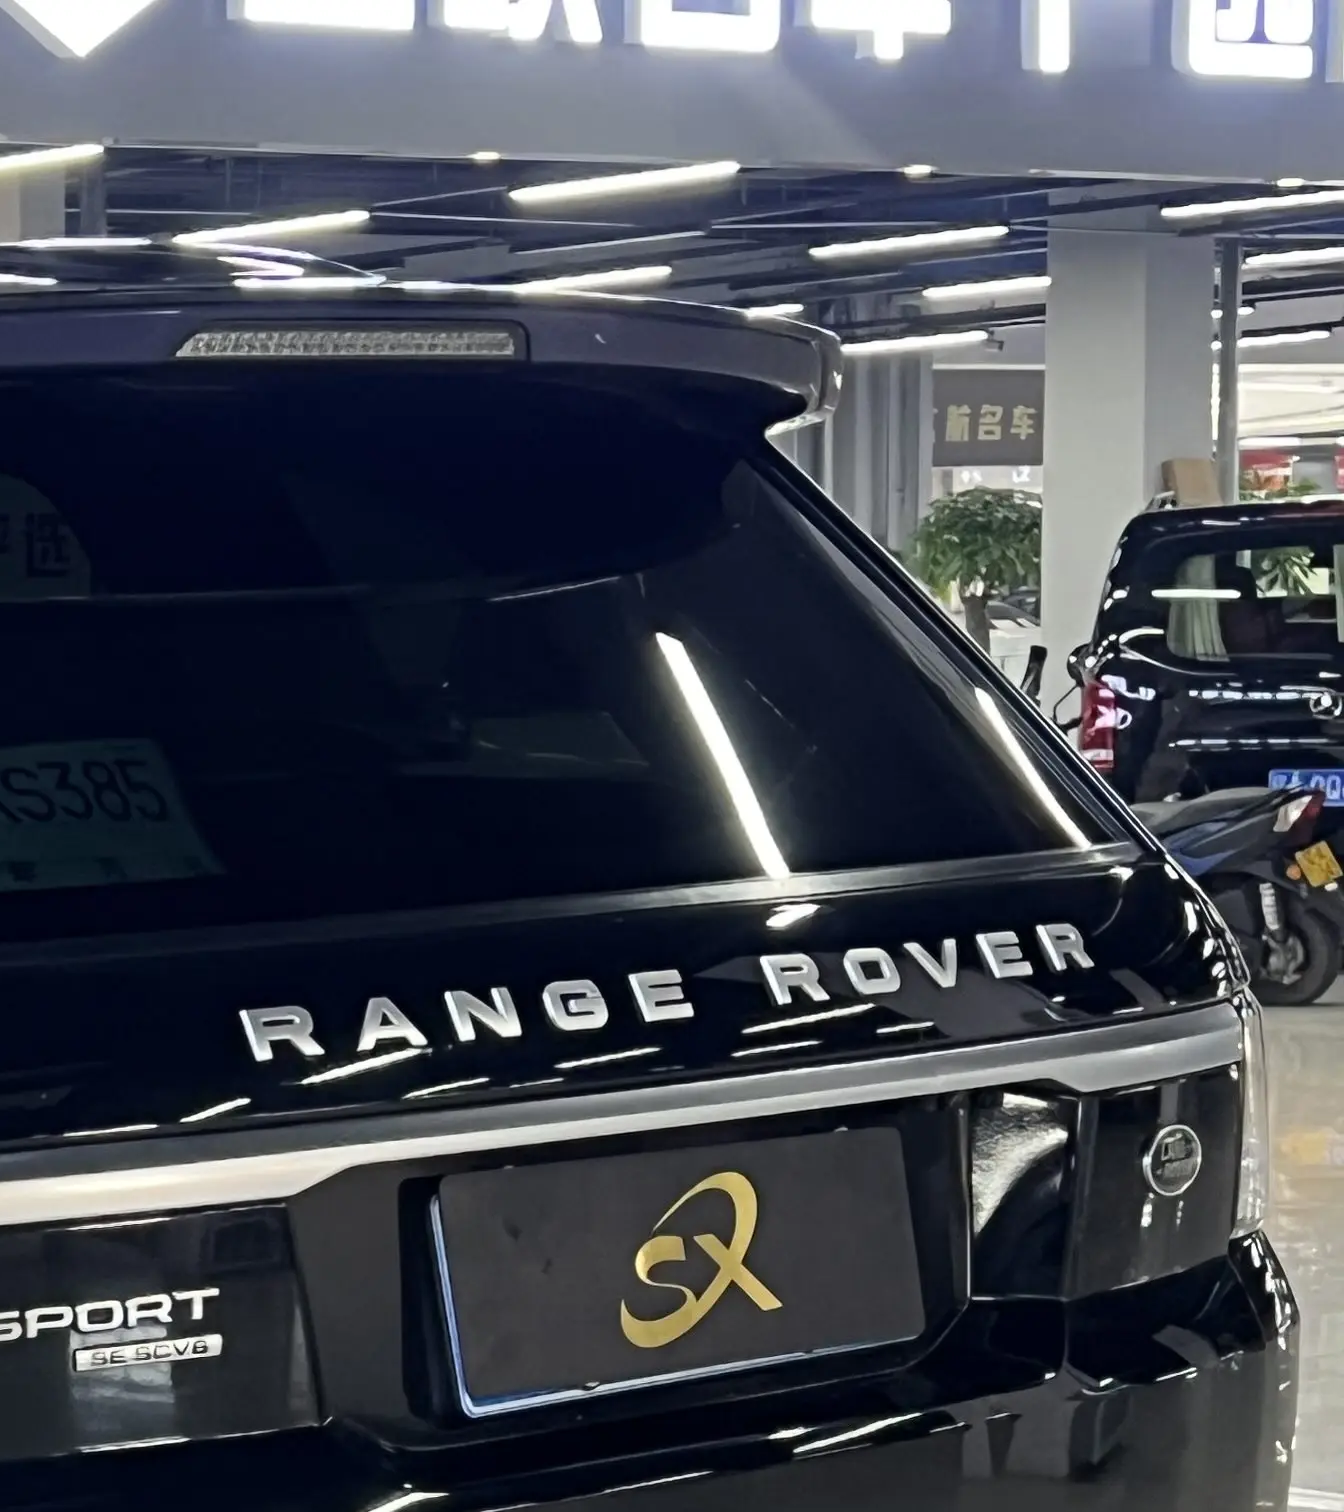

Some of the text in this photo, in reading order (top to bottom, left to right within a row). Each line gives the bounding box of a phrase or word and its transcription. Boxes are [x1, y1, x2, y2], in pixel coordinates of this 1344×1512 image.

[239, 921, 1096, 1064] RANGE ROVER
[90, 1349, 127, 1367] SE
